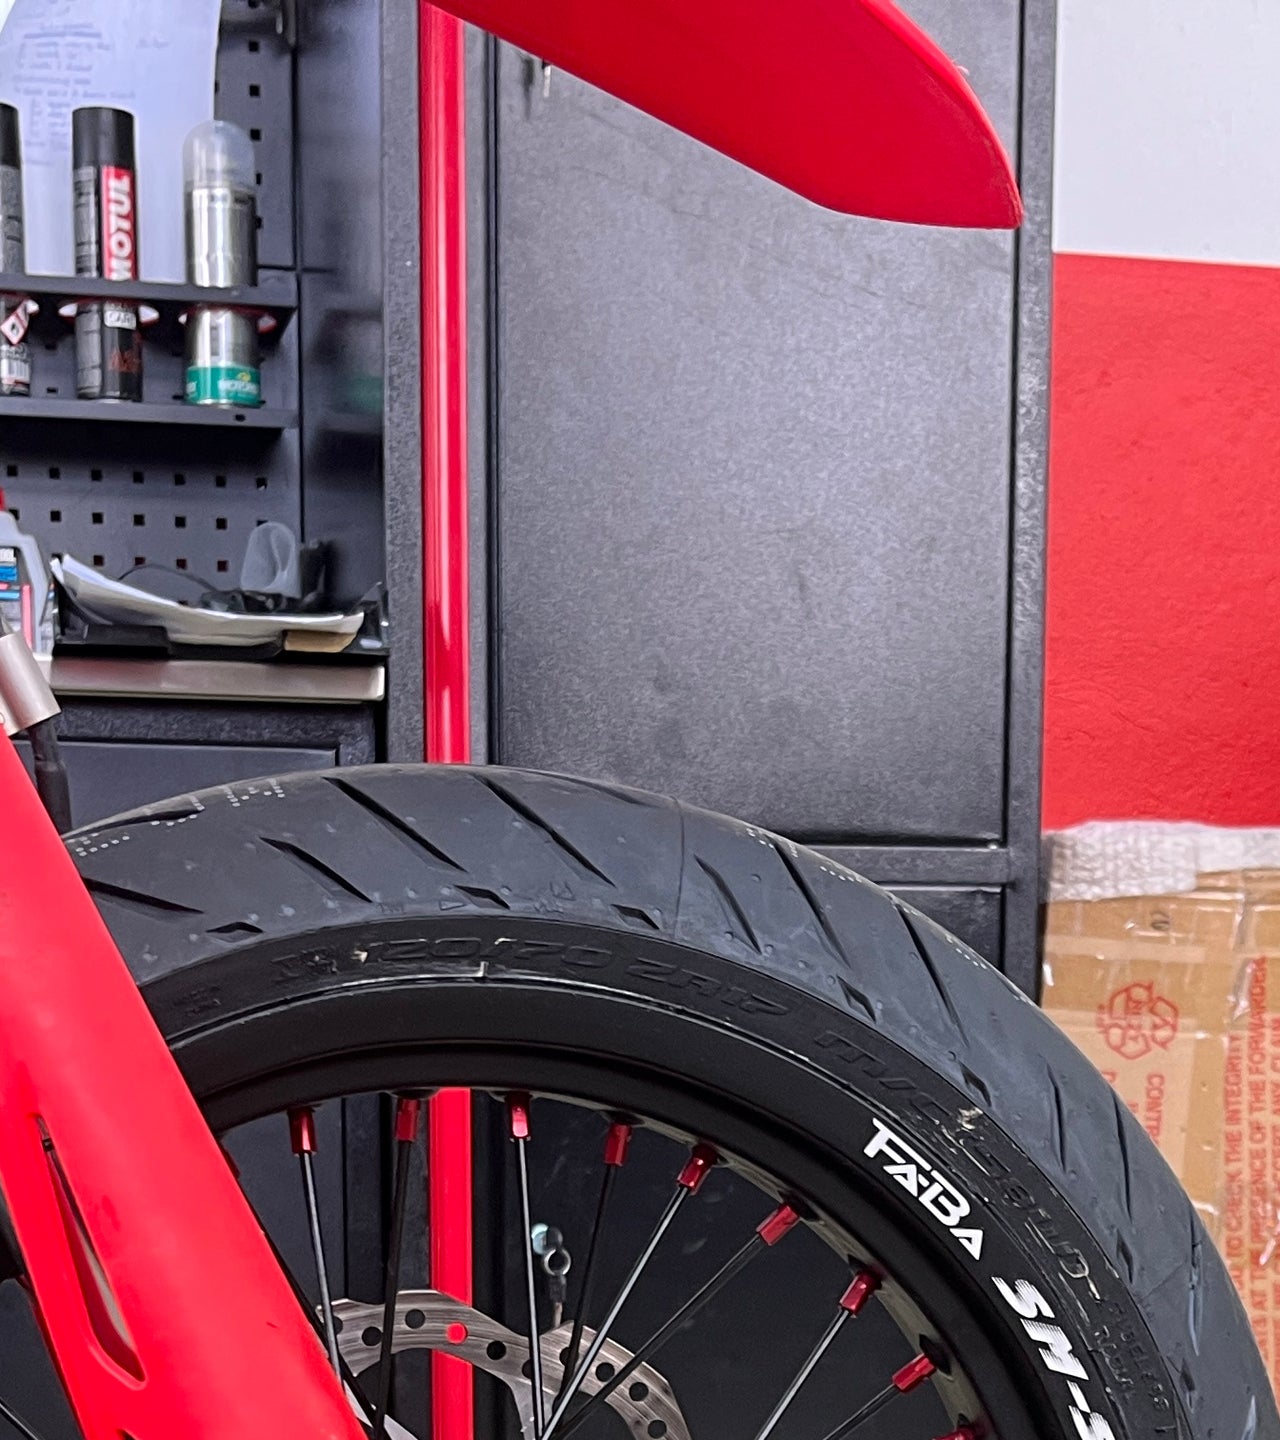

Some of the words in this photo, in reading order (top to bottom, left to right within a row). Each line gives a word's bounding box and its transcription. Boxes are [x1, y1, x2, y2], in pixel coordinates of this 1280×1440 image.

[1224, 1033, 1242, 1125] INTEGRITY
[1249, 1080, 1267, 1114] THE
[1224, 1130, 1242, 1165] THE
